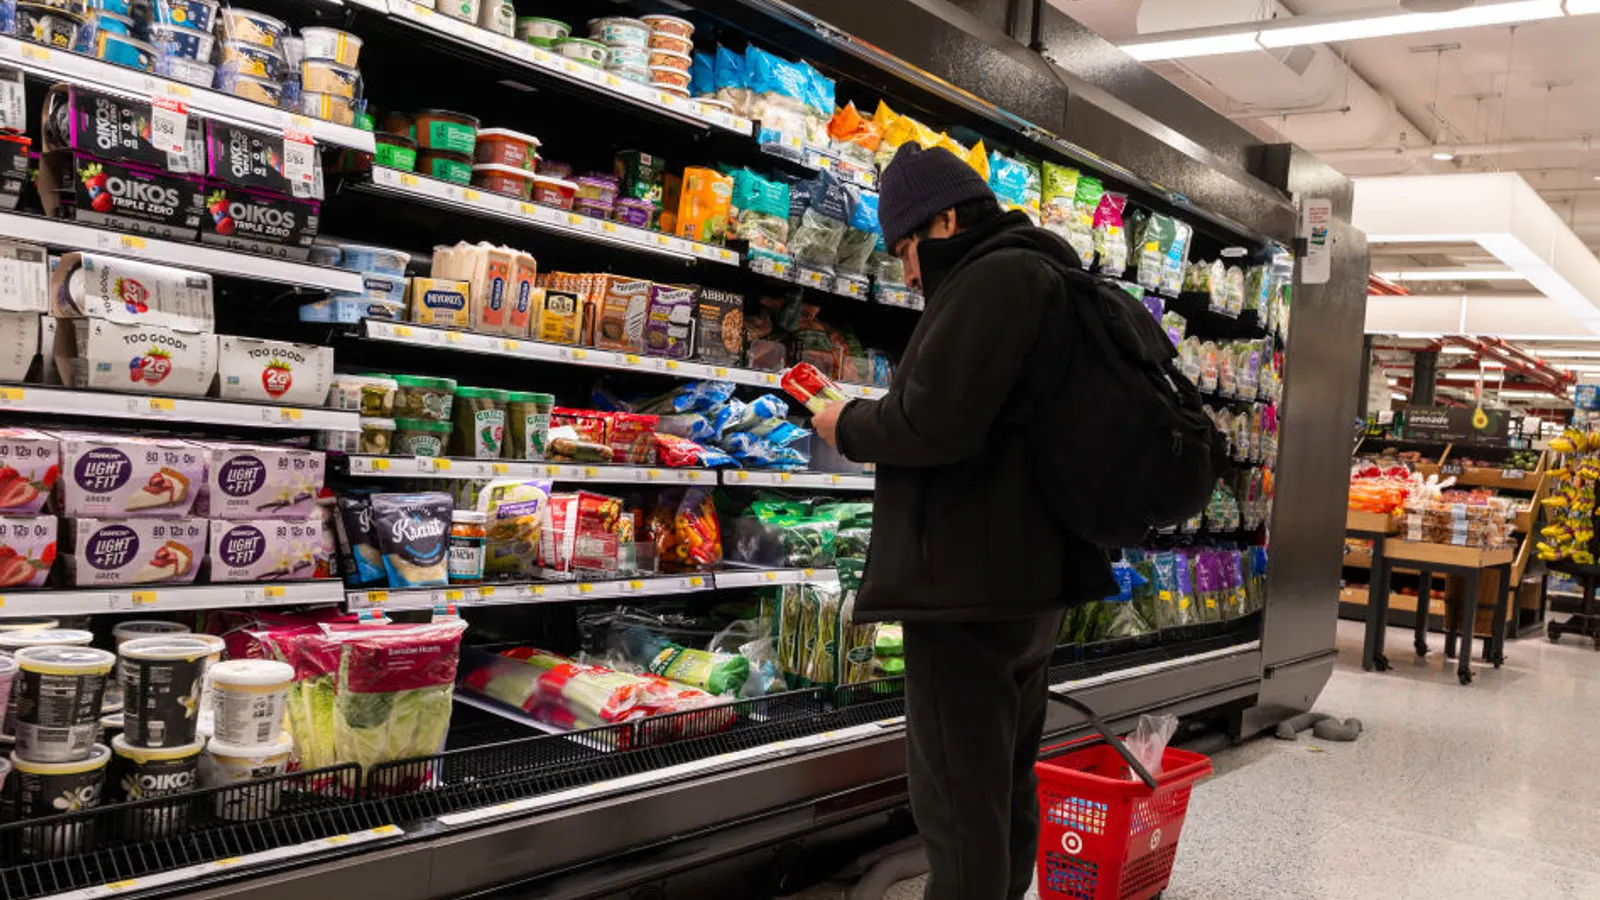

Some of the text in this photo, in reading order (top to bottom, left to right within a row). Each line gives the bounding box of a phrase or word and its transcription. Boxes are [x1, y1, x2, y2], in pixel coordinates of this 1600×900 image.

[97, 99, 111, 149] OIKOS
[230, 129, 243, 177] OIKOS
[105, 177, 179, 206] OIKOS
[112, 196, 145, 210] TRIPLE
[147, 204, 174, 215] ZERO
[228, 202, 295, 229] OIKOS
[234, 221, 263, 233] TRIPLE
[265, 226, 290, 237] ZERO
[123, 333, 147, 345] TOO
[248, 347, 269, 358] TOO
[143, 359, 167, 372] 2G
[267, 370, 287, 384] 2G
[84, 460, 128, 477] LIGHT
[227, 467, 262, 482] LIGHT
[392, 517, 444, 543] Kraut
[94, 536, 136, 555] LIGHT
[228, 536, 262, 552] LIGHT
